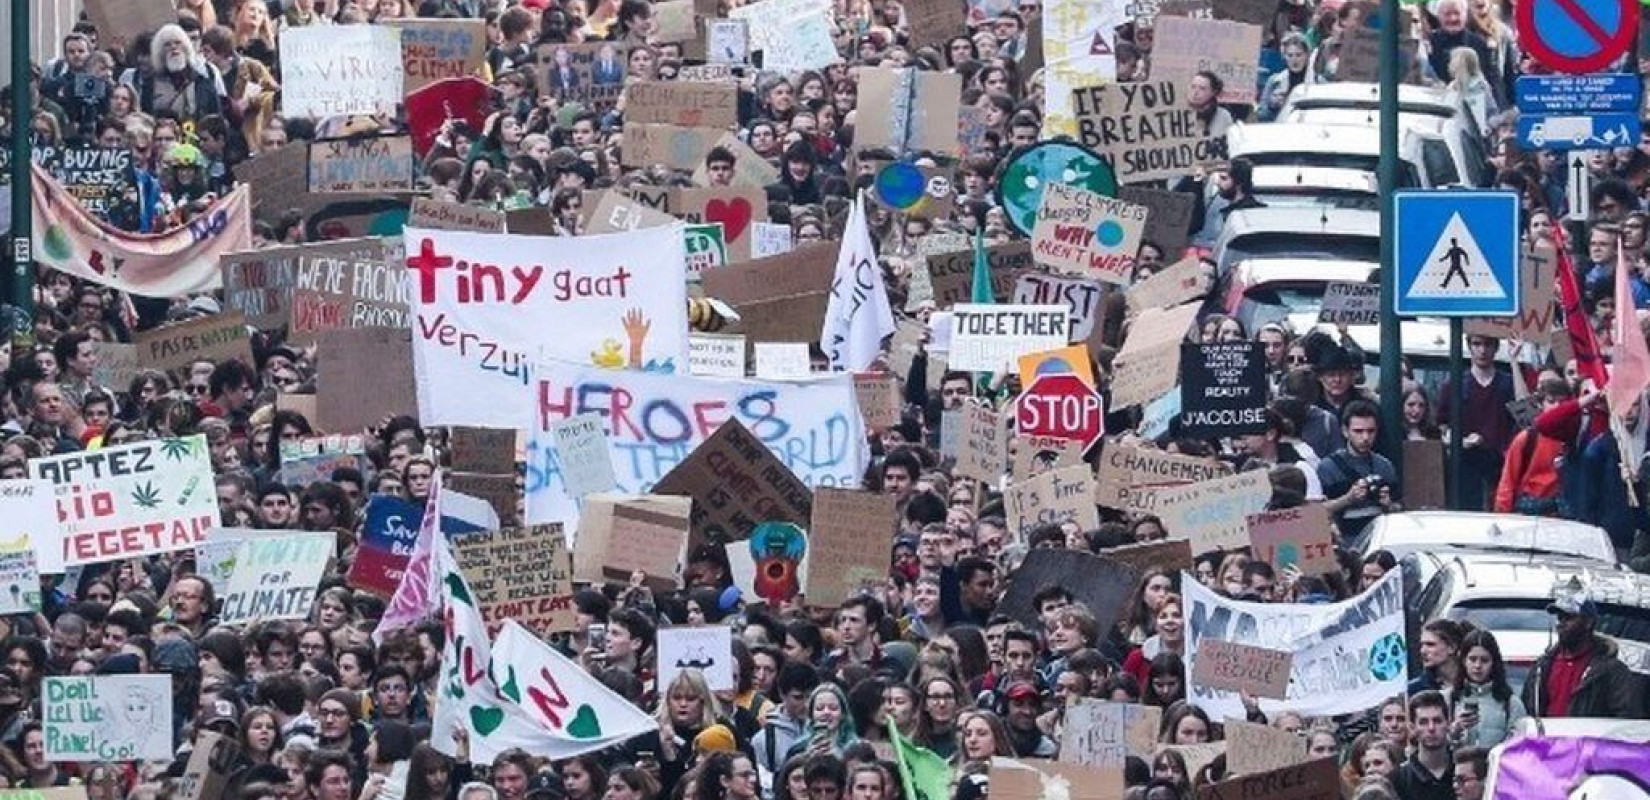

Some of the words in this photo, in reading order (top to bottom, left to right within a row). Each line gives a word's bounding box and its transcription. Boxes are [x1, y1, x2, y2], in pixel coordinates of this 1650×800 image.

[1072, 85, 1108, 116] IF
[1120, 81, 1175, 113] YOU
[1079, 110, 1195, 149] BREATHE
[1122, 144, 1191, 176] SHOULD
[1054, 223, 1097, 248] WHY
[405, 238, 544, 304] tiny
[553, 265, 632, 302] gaat
[1021, 278, 1098, 319] JUST
[953, 312, 1065, 336] TOGETHER
[1023, 392, 1099, 435] STOP
[1182, 408, 1266, 427] J'ACCUSE
[222, 586, 317, 622] CLIMATE
